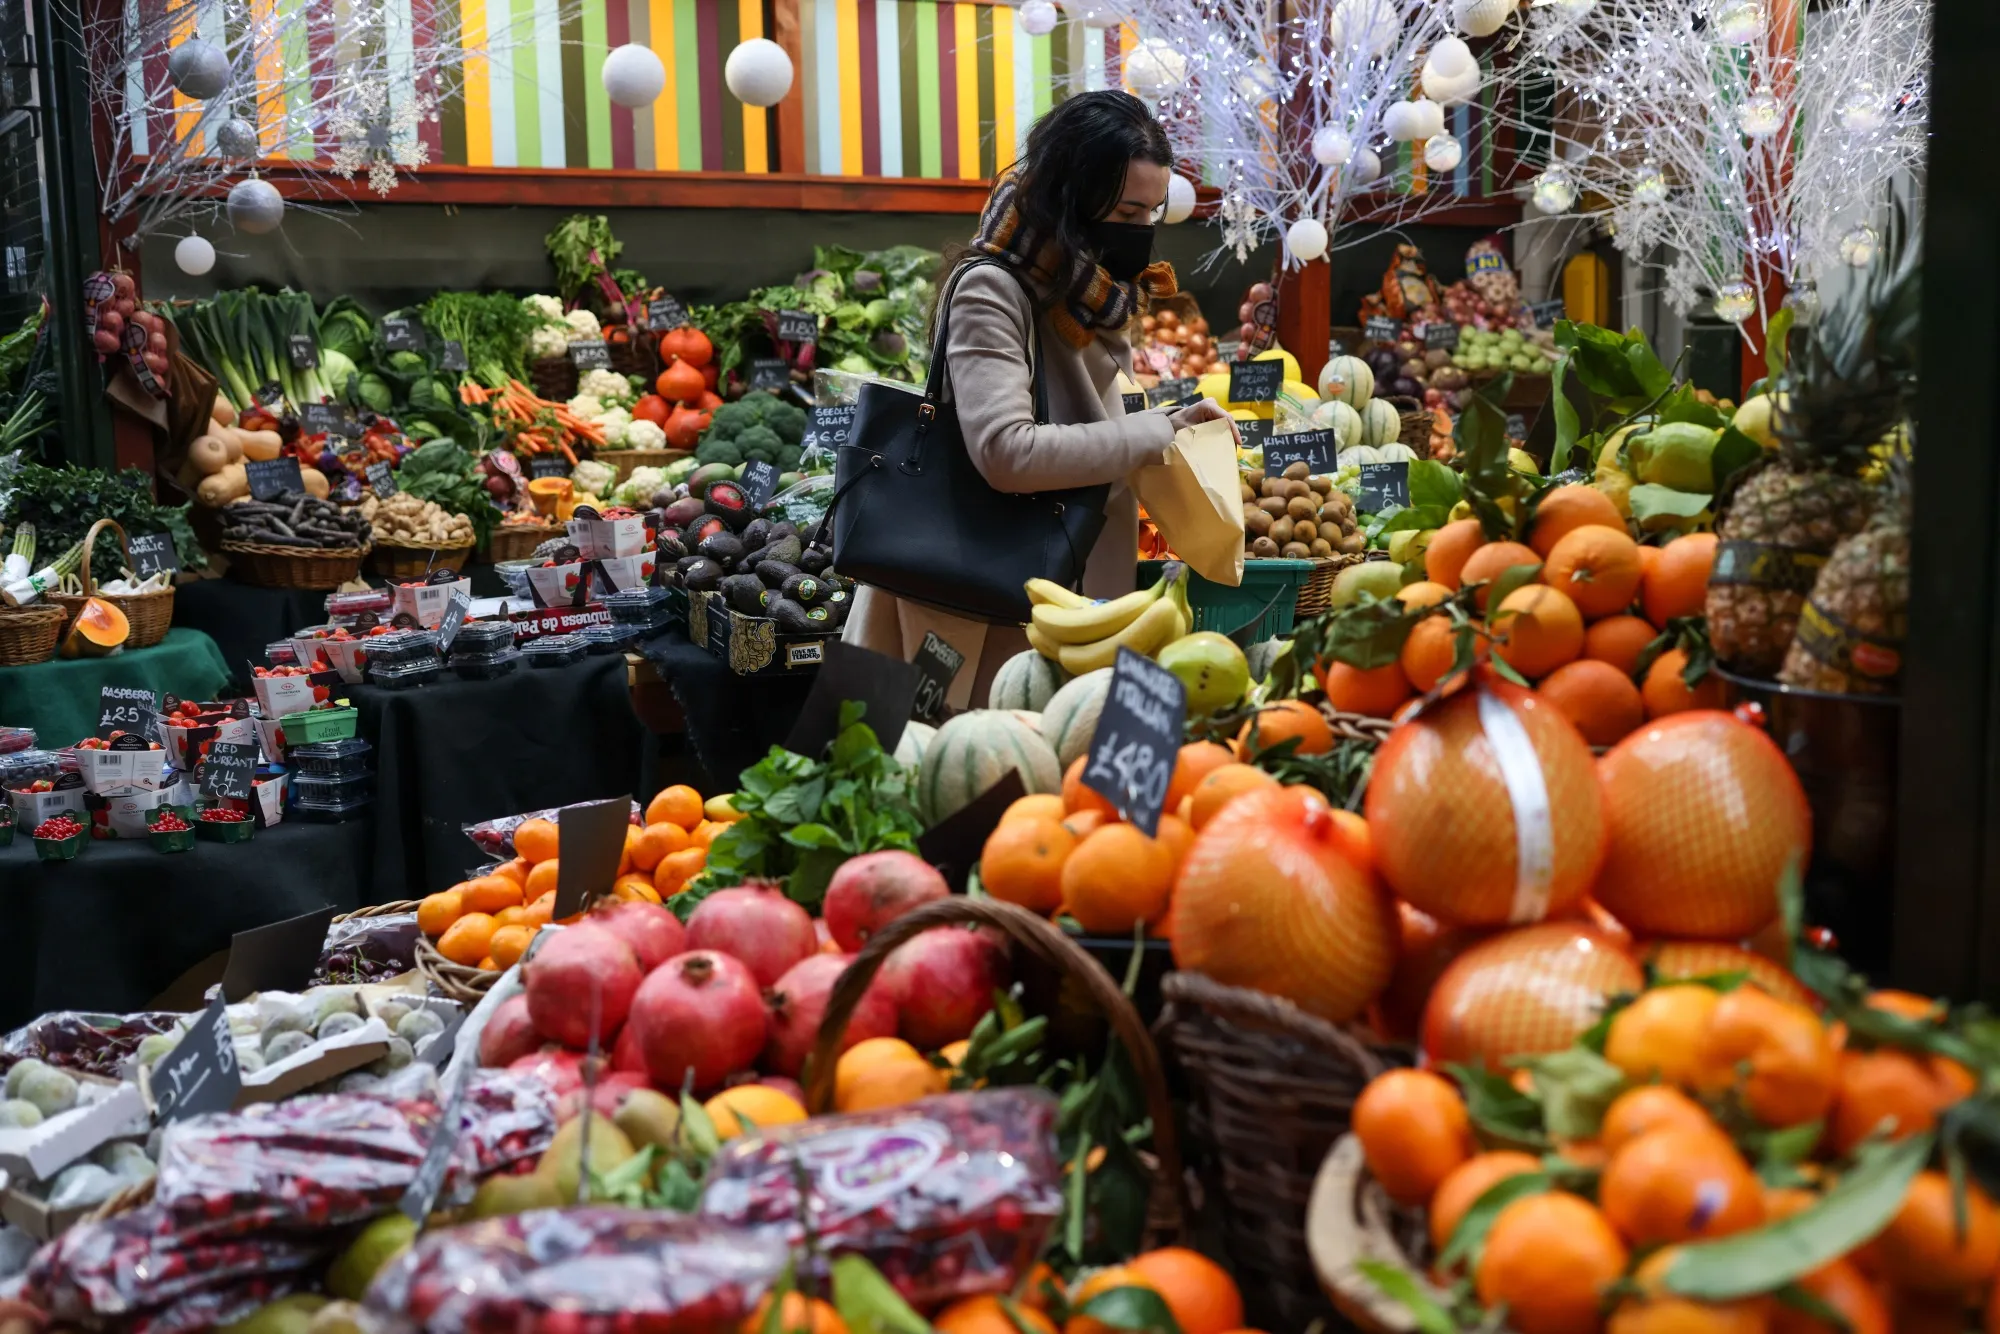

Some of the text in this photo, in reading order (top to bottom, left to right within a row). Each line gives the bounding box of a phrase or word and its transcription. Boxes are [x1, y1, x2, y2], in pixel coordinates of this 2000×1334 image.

[817, 416, 851, 427] GRAPE
[1263, 432, 1329, 447] KIWI FRUIT
[1270, 452, 1283, 467] 3
[1285, 453, 1304, 462] FOR
[756, 461, 772, 475] BEST
[748, 471, 771, 487] MANGO
[132, 535, 155, 546] WET
[129, 542, 165, 555] GARLIC
[542, 617, 558, 631] de
[99, 706, 140, 727] £2.5
[324, 726, 341, 735] Fruit
[214, 743, 238, 754] RED
[206, 755, 256, 769] CURRANT
